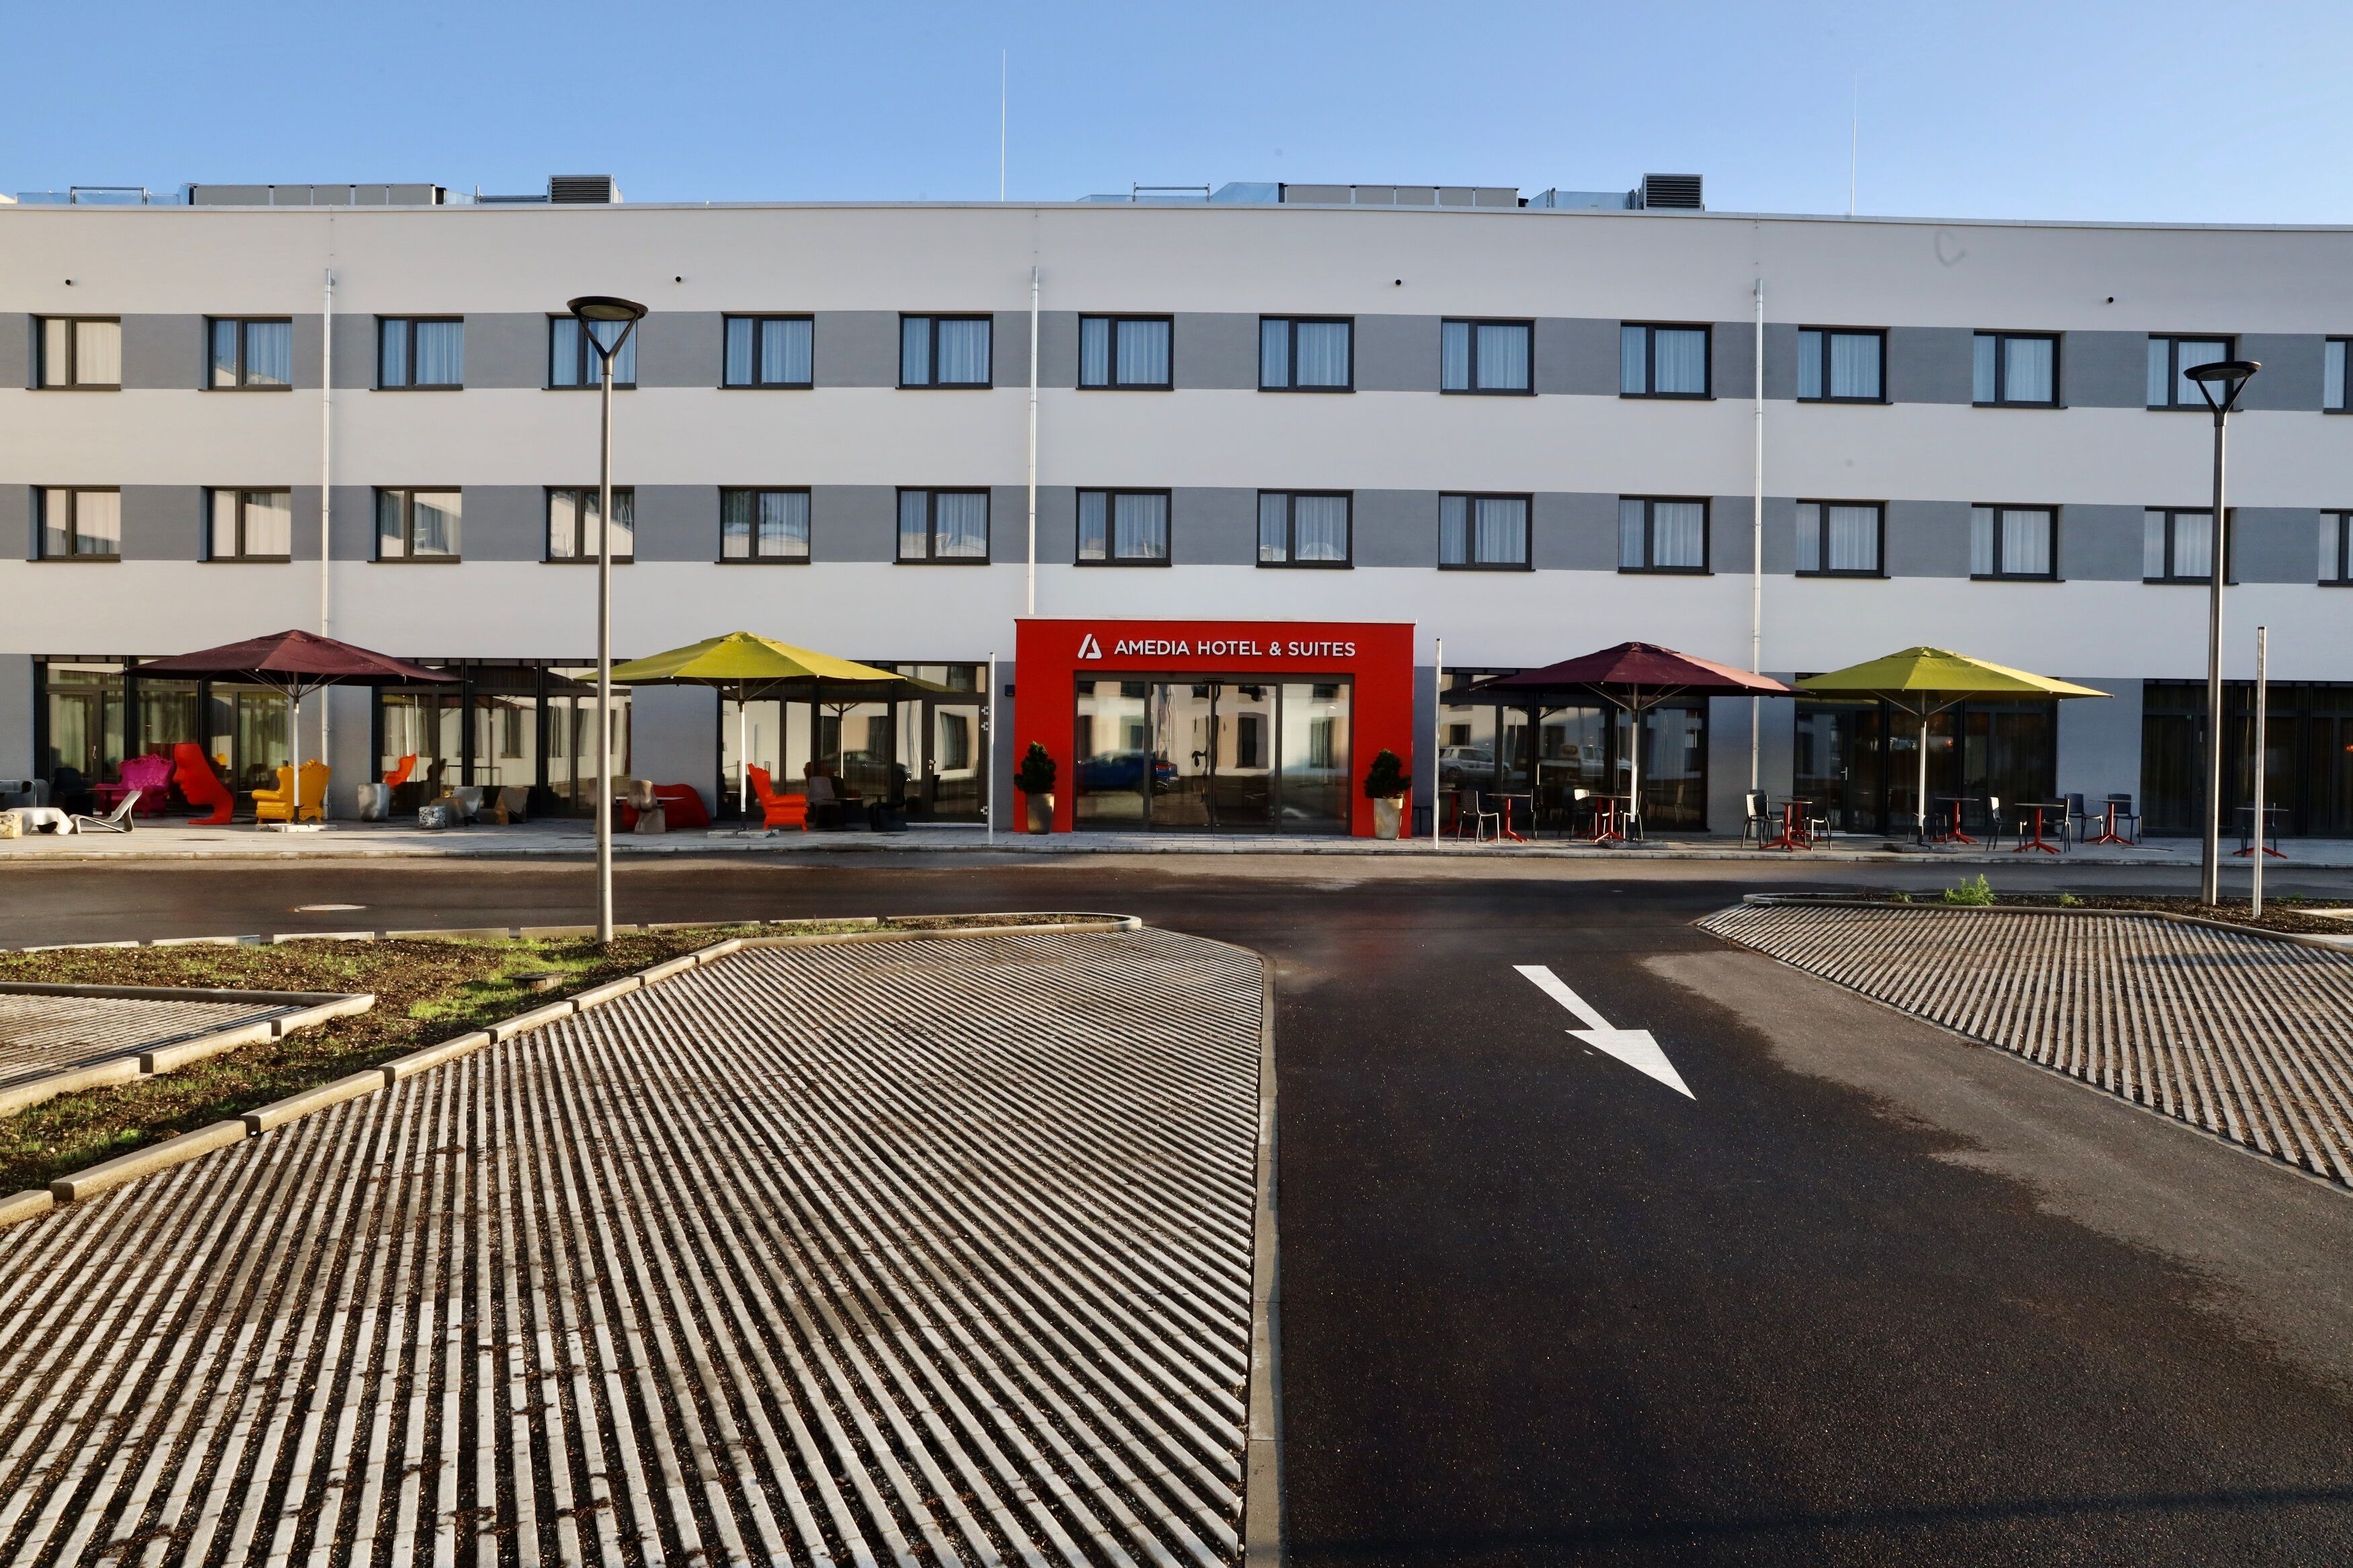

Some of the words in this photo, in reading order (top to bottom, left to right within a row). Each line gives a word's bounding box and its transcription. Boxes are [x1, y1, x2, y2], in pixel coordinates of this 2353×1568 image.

[1113, 639, 1191, 655] AMEDIA
[1197, 641, 1263, 655] HOTEL
[1269, 641, 1281, 656] &
[1287, 641, 1356, 657] SUITES
